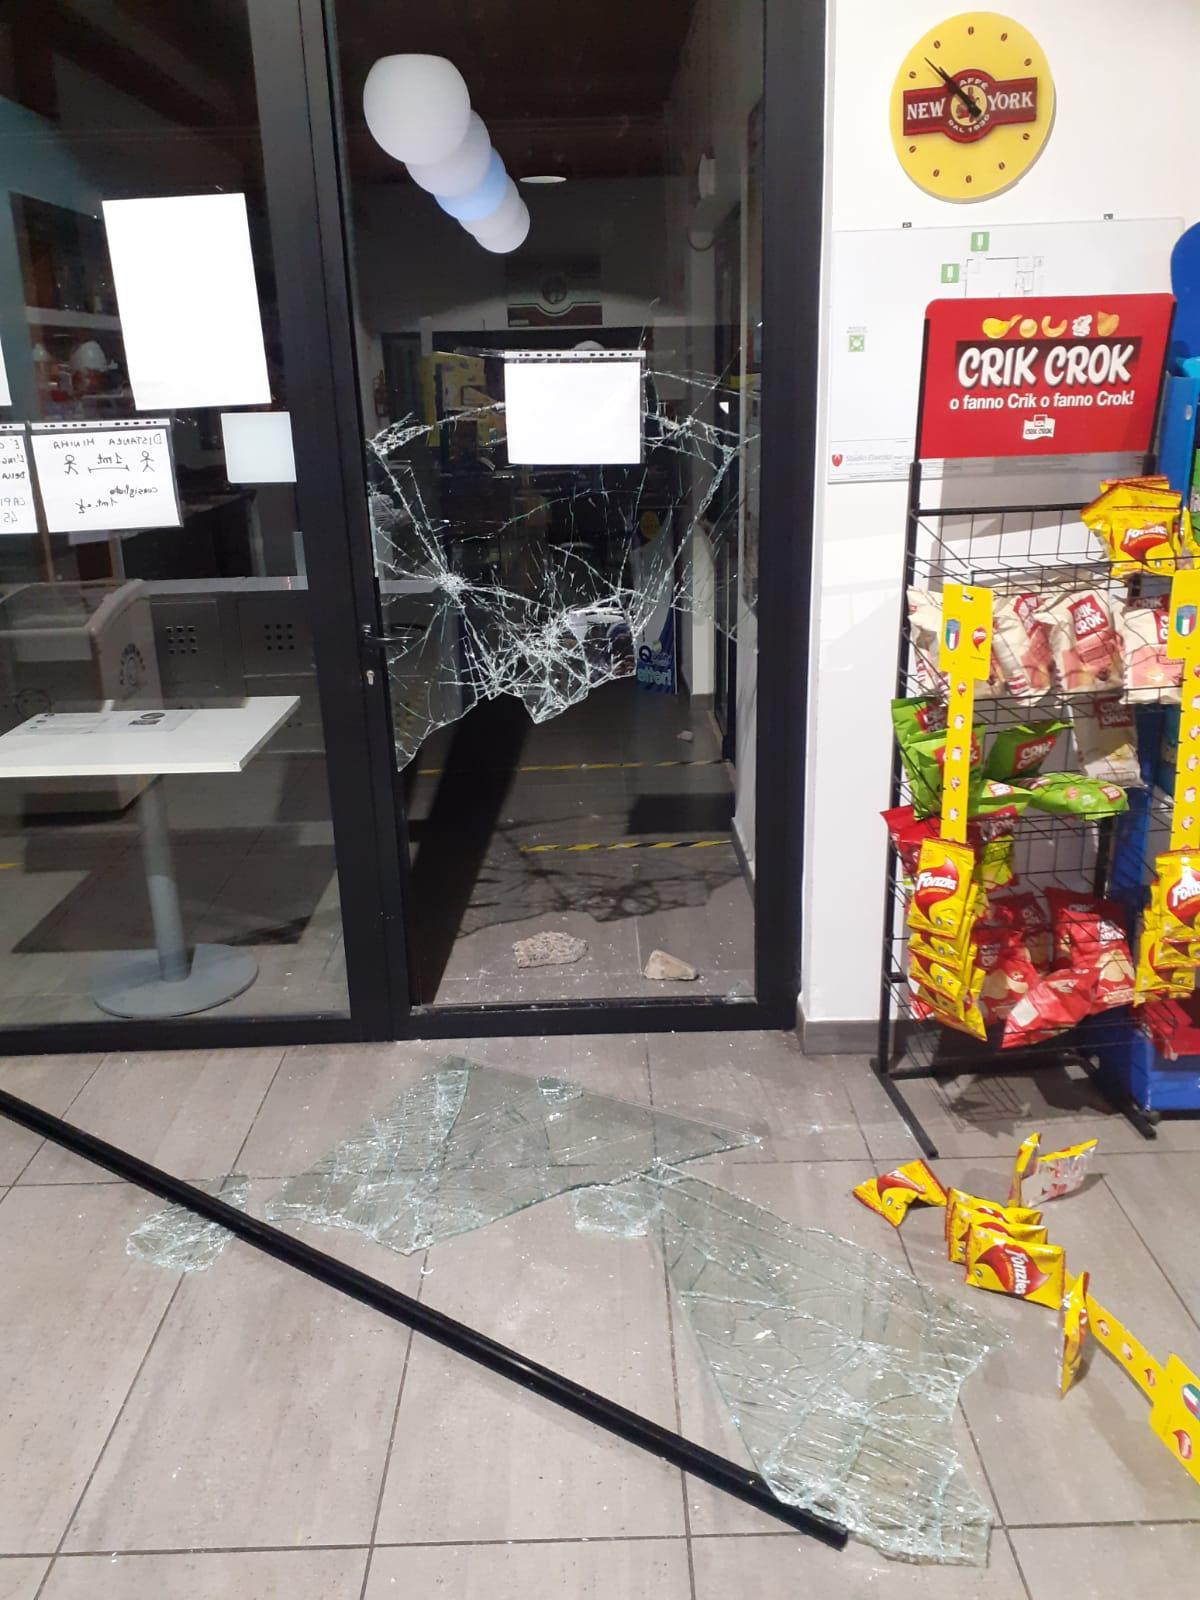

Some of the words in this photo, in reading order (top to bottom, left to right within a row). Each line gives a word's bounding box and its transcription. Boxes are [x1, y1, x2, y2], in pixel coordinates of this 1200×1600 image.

[906, 97, 947, 120] NEW
[987, 91, 1034, 111] YORK
[948, 119, 965, 133] DAL
[957, 345, 1039, 388] CRIK
[1044, 344, 1135, 387] CROK
[949, 399, 960, 410] o
[963, 395, 1004, 409] fanno
[1007, 393, 1037, 408] Crik
[1040, 398, 1050, 408] o
[1053, 393, 1093, 407] fanno
[1096, 390, 1135, 406] Crok!
[1075, 612, 1105, 634] CROK
[1005, 1248, 1031, 1295] Fonzies
